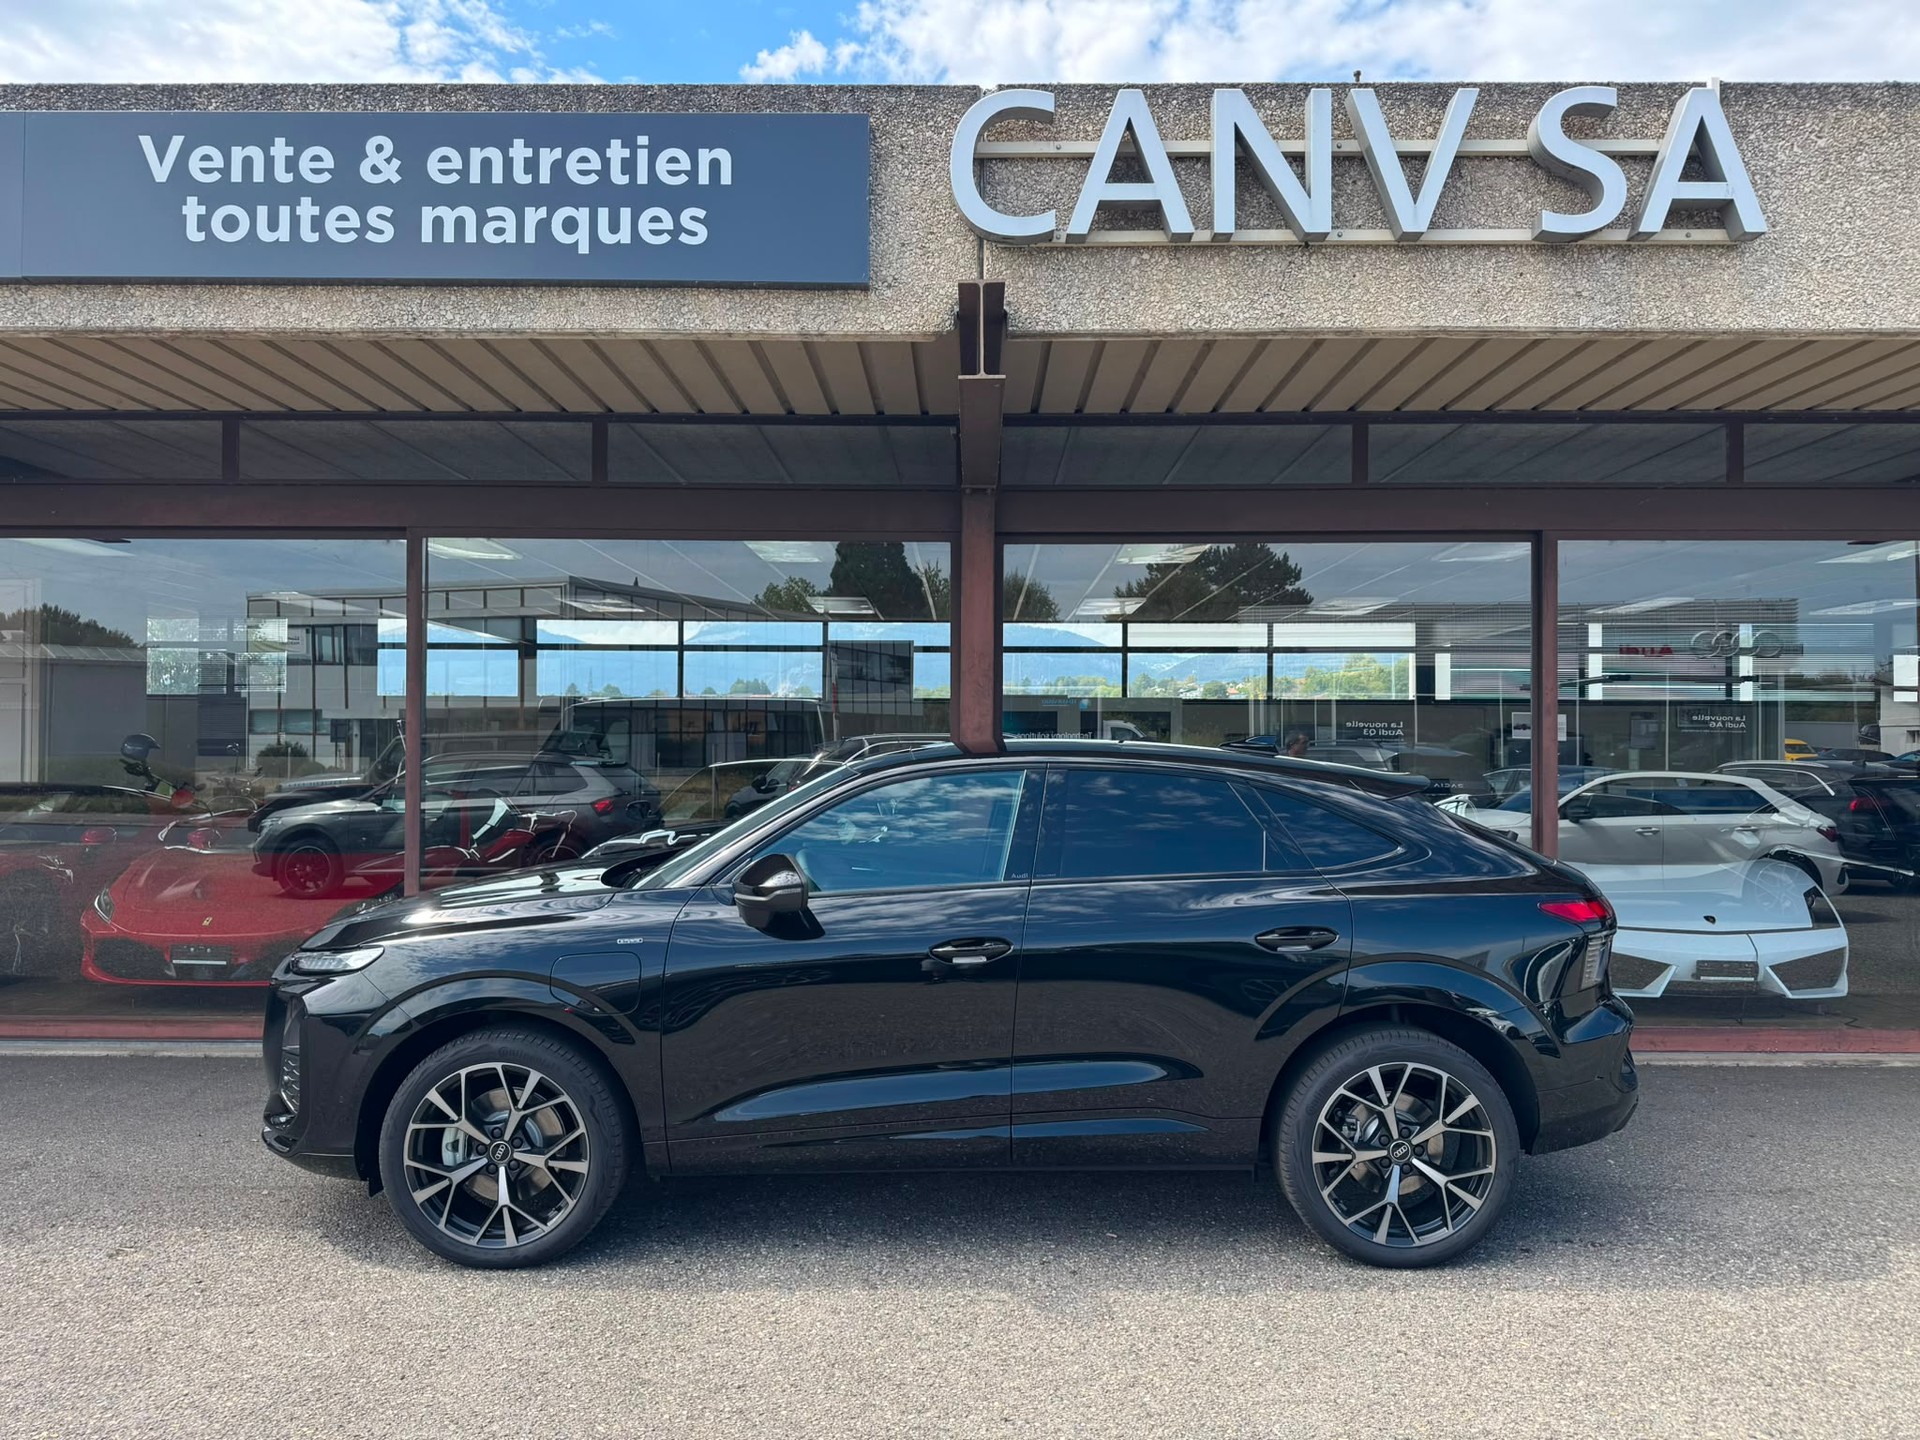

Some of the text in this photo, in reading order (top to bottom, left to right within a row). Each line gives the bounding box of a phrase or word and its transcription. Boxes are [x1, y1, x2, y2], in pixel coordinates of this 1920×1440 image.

[138, 135, 733, 186] Vente & entretien
[950, 86, 1767, 240] CANV SA
[182, 196, 708, 255] toutes marques
